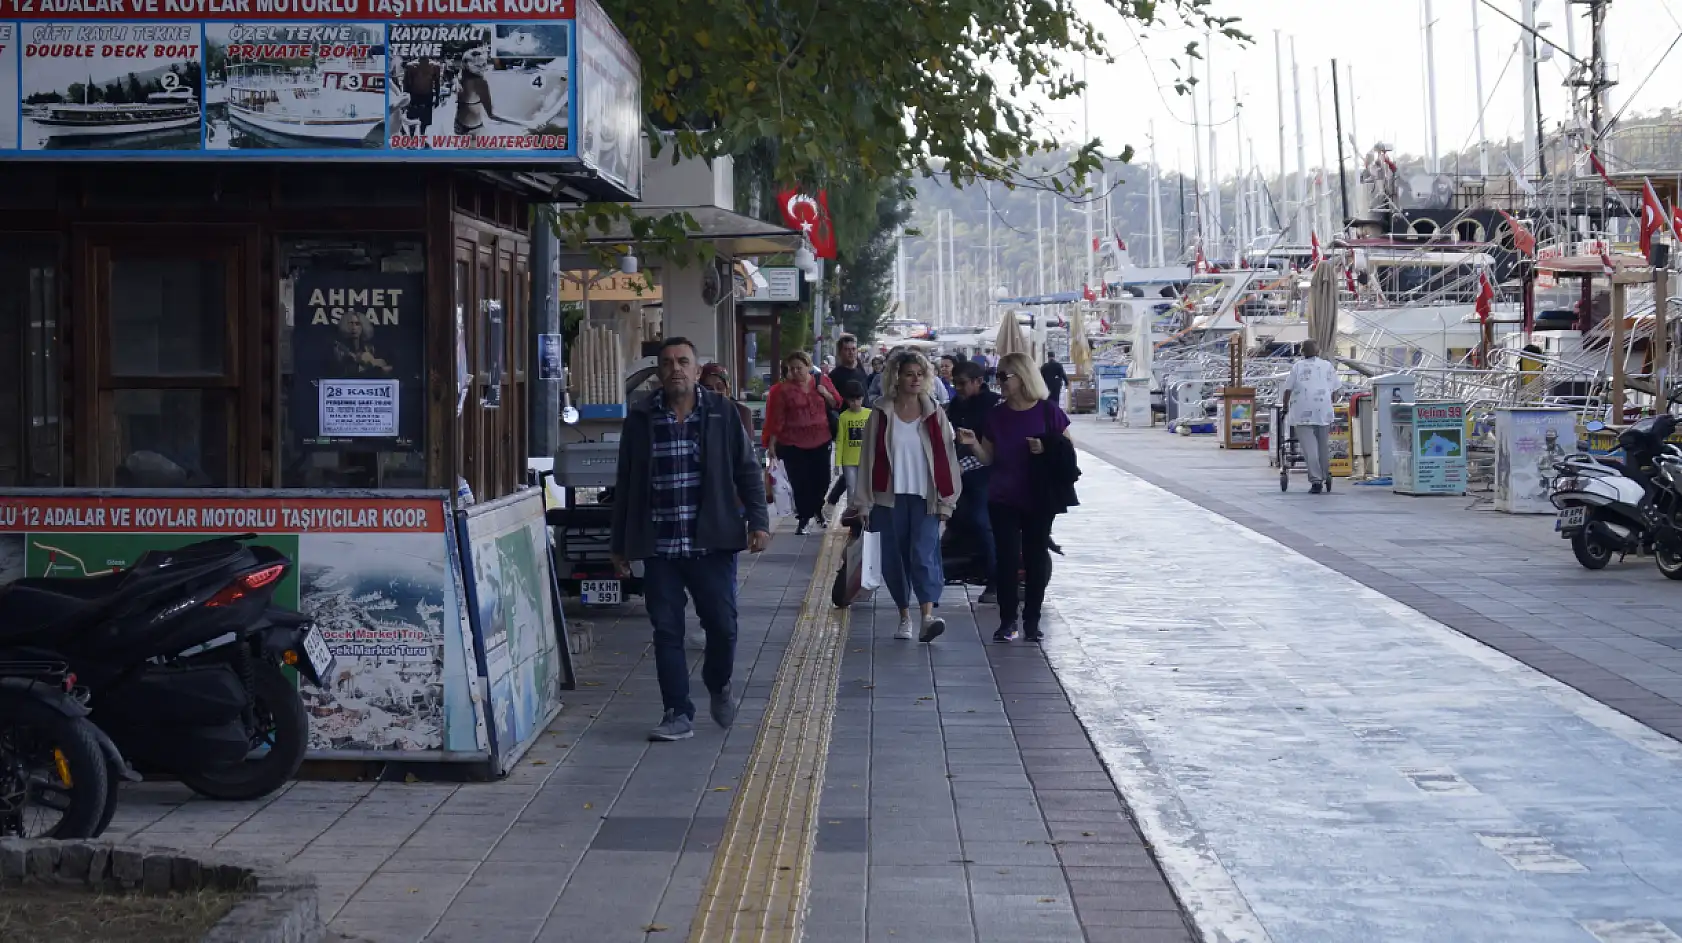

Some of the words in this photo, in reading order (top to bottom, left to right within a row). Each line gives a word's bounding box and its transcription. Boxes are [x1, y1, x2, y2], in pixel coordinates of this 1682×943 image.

[33, 24, 74, 44] ÇİFT
[77, 26, 129, 41] KATLI
[132, 26, 192, 41] TEKNE
[228, 24, 278, 42] ÖZEL
[285, 26, 352, 41] TEKNE
[390, 26, 485, 42] KAYDIRAKLI
[25, 44, 96, 58] DOUBLE
[102, 44, 149, 58] DECK
[153, 44, 199, 58] BOAT
[227, 44, 315, 58] PRIVATE
[318, 44, 371, 58] BOAT
[391, 43, 442, 57] TEKNE
[164, 75, 176, 87] 2
[348, 75, 359, 88] 3
[531, 75, 543, 88] 4
[391, 135, 428, 149] BOAT
[432, 135, 472, 149] WITH
[475, 135, 566, 149] WATERSLIDE
[308, 289, 403, 306] AHMET
[311, 307, 399, 325] ASAN
[326, 386, 342, 398] 28
[347, 386, 391, 398] KASIM
[1417, 407, 1447, 419] Velim
[1448, 407, 1462, 418] 99
[22, 507, 40, 526] 12
[44, 508, 106, 526] ADALAR
[110, 508, 130, 526] VE
[135, 508, 198, 527] KOYLAR
[201, 508, 277, 527] MOTORLU
[281, 508, 379, 531] TAŞIYICILAR
[382, 508, 428, 527] KOOP.
[583, 582, 597, 591] 34
[599, 582, 618, 592] KHM
[355, 629, 398, 640] Market
[400, 629, 423, 642] Trip
[354, 645, 397, 656] Market
[398, 645, 427, 656] Turu
